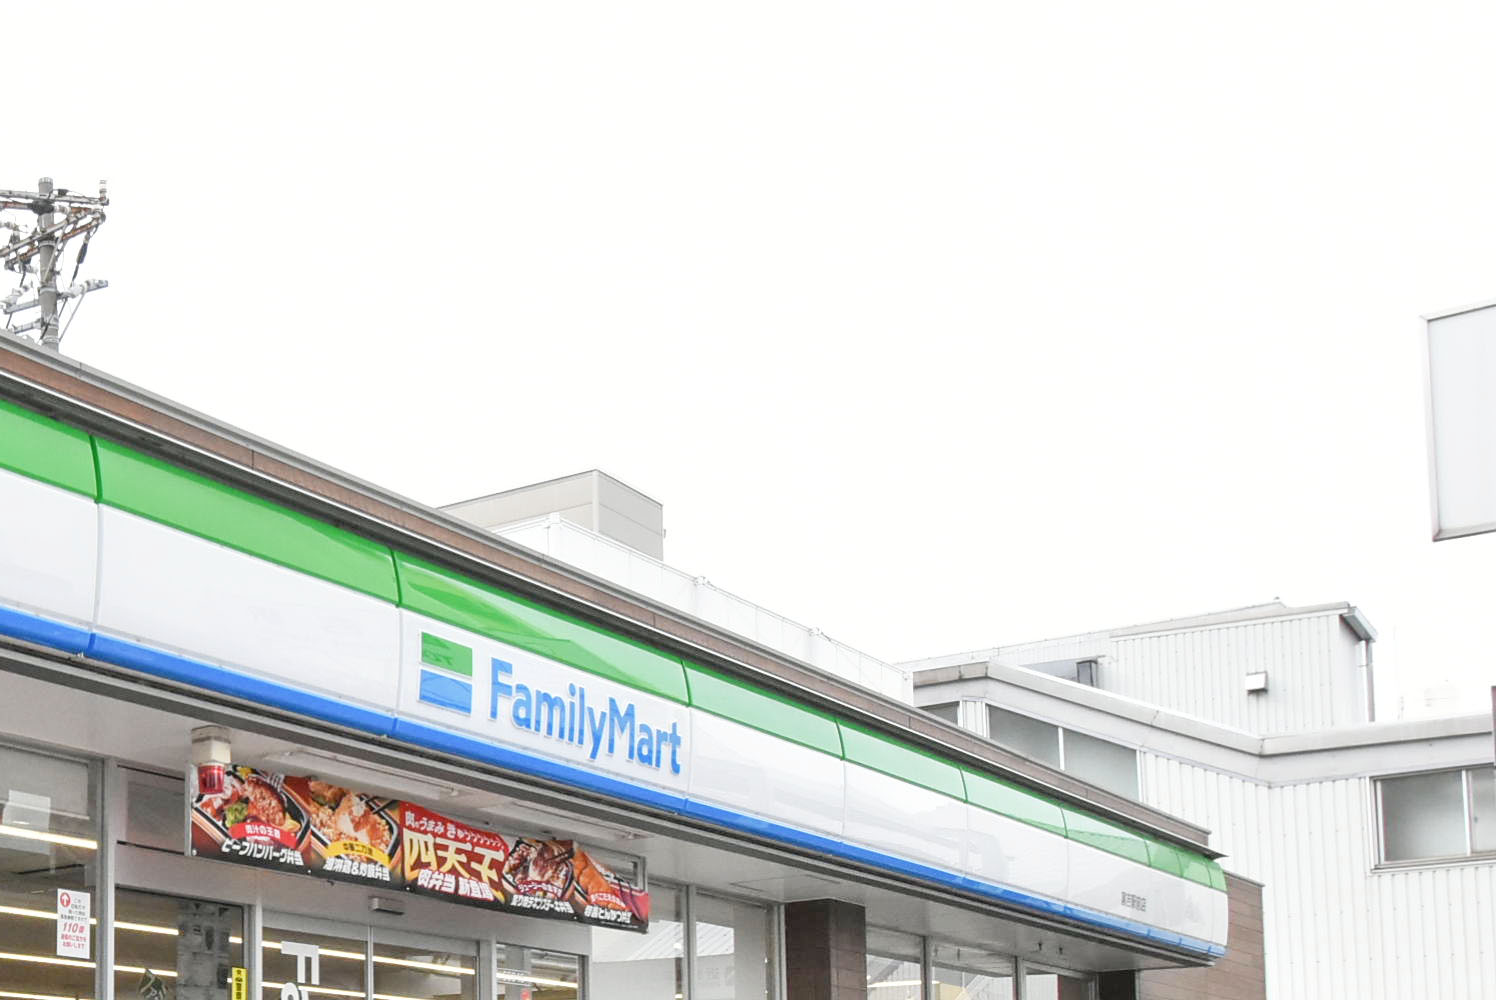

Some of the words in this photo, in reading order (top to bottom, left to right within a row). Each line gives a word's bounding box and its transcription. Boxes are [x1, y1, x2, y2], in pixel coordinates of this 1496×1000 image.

[490, 657, 682, 775] FamilyMart
[221, 838, 304, 866] ビーフハンバーグ弁当
[403, 828, 505, 904] 四天王
[417, 869, 456, 894] 肉弁当
